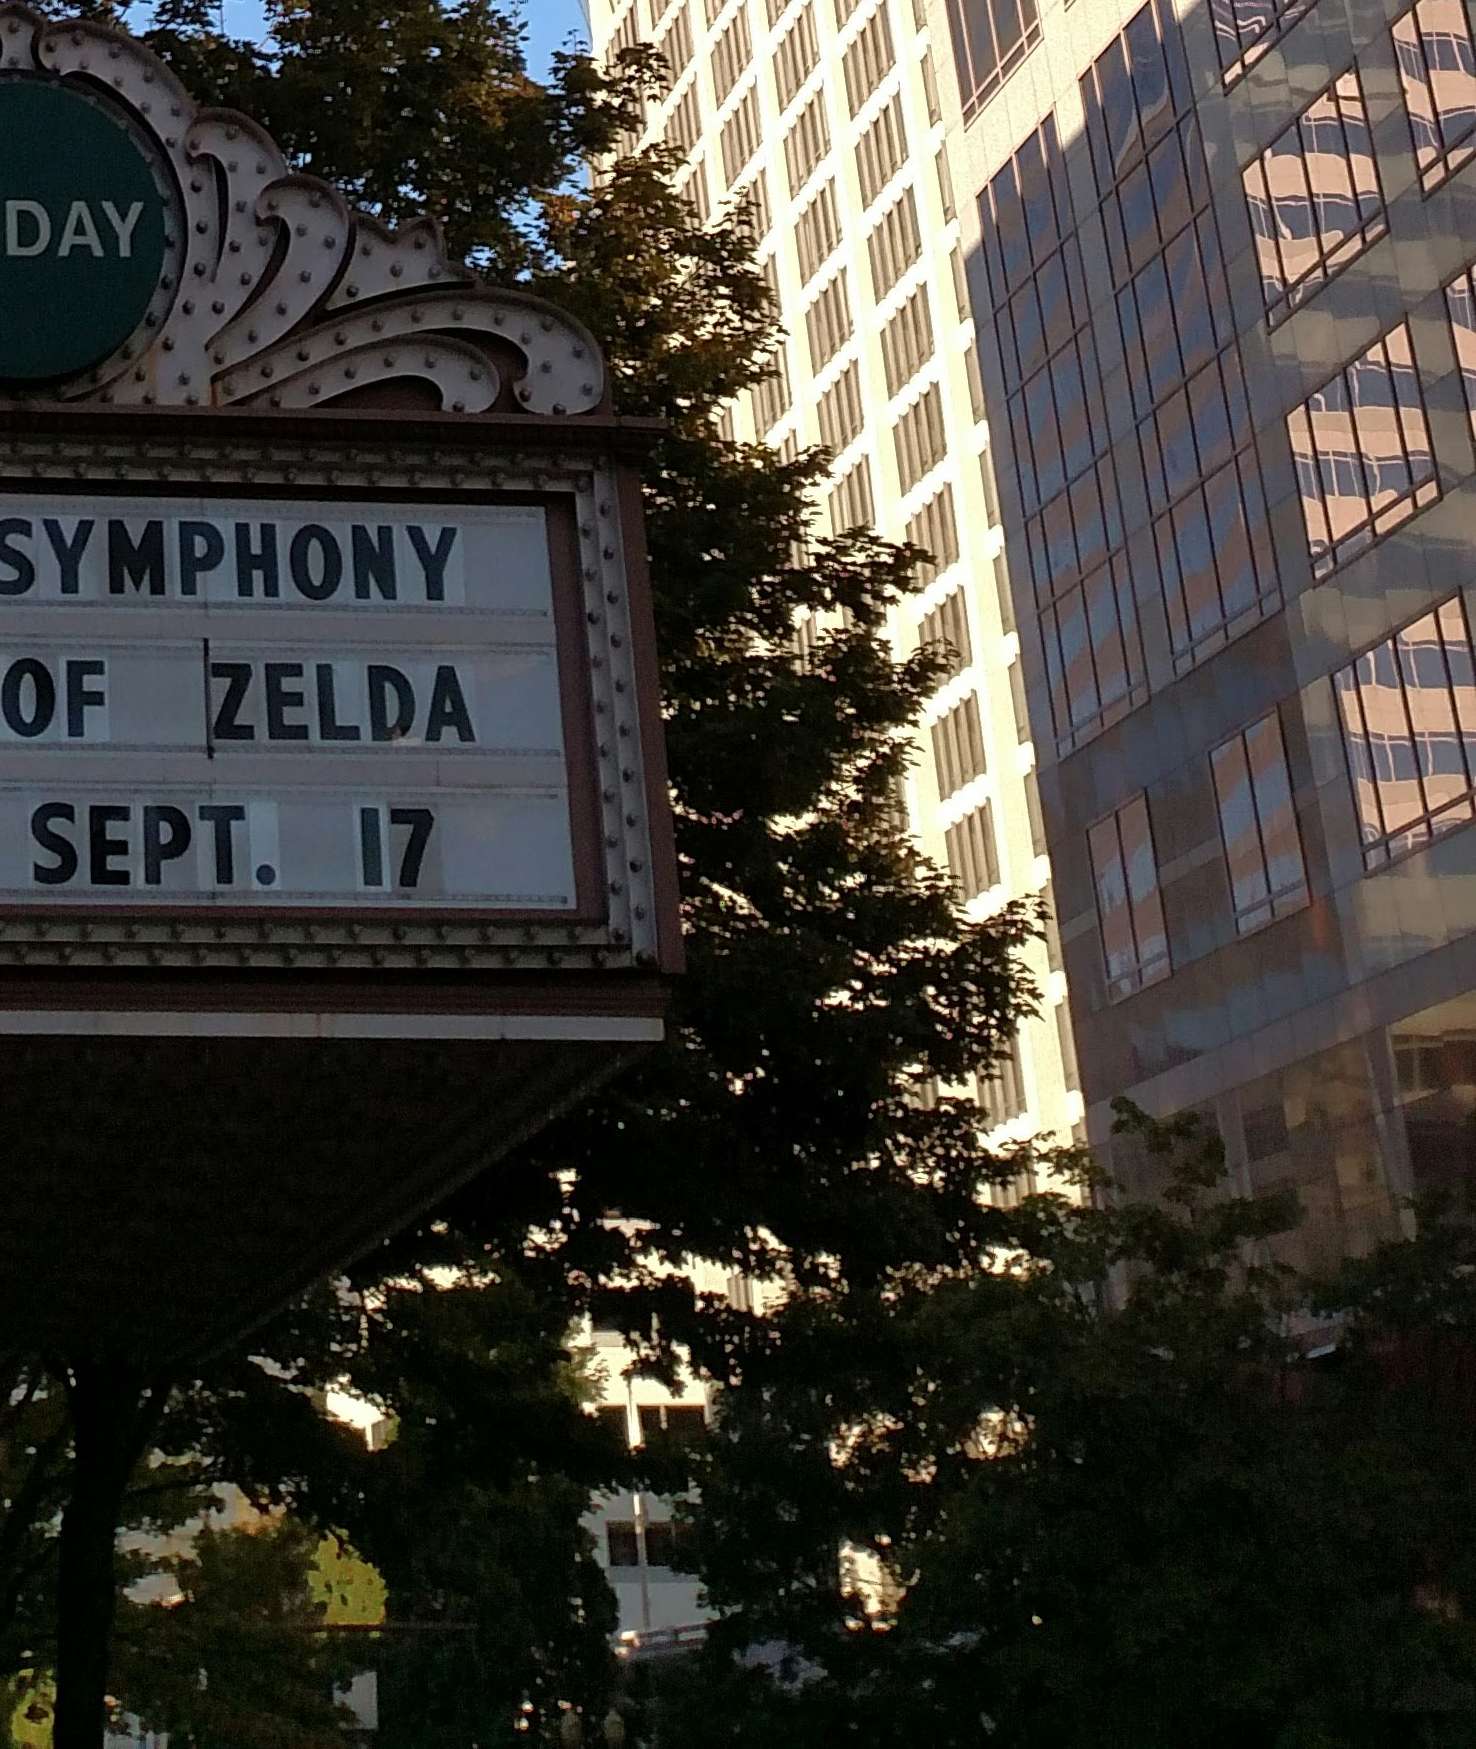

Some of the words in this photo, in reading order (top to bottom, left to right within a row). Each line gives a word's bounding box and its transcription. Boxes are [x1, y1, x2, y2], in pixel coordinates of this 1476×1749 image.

[1, 657, 106, 738] OF
[211, 661, 477, 743] ZELDA
[30, 801, 276, 887] SEPT.
[360, 806, 435, 889] 17
